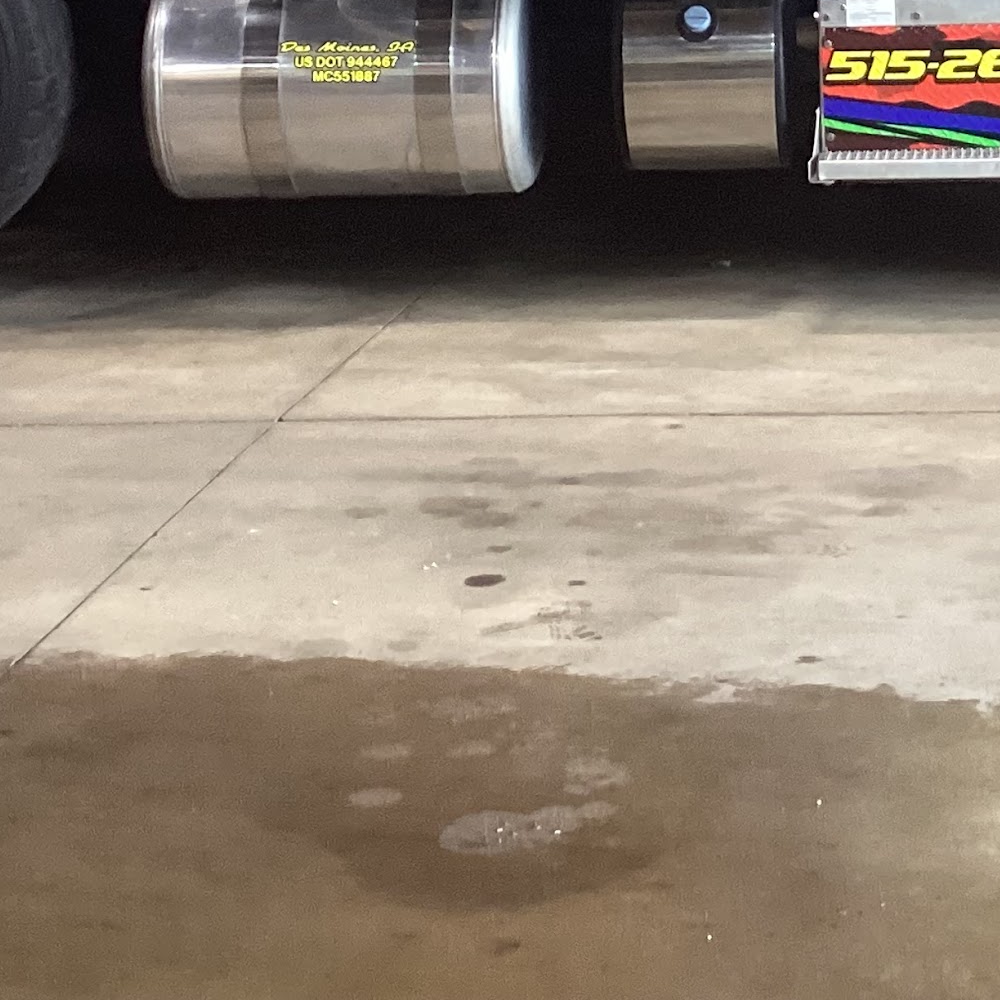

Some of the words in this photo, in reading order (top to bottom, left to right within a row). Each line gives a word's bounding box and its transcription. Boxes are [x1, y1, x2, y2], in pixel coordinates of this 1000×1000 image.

[281, 41, 311, 53] Des
[294, 56, 313, 68] US
[316, 56, 344, 68] DOT
[346, 56, 399, 68] 944467
